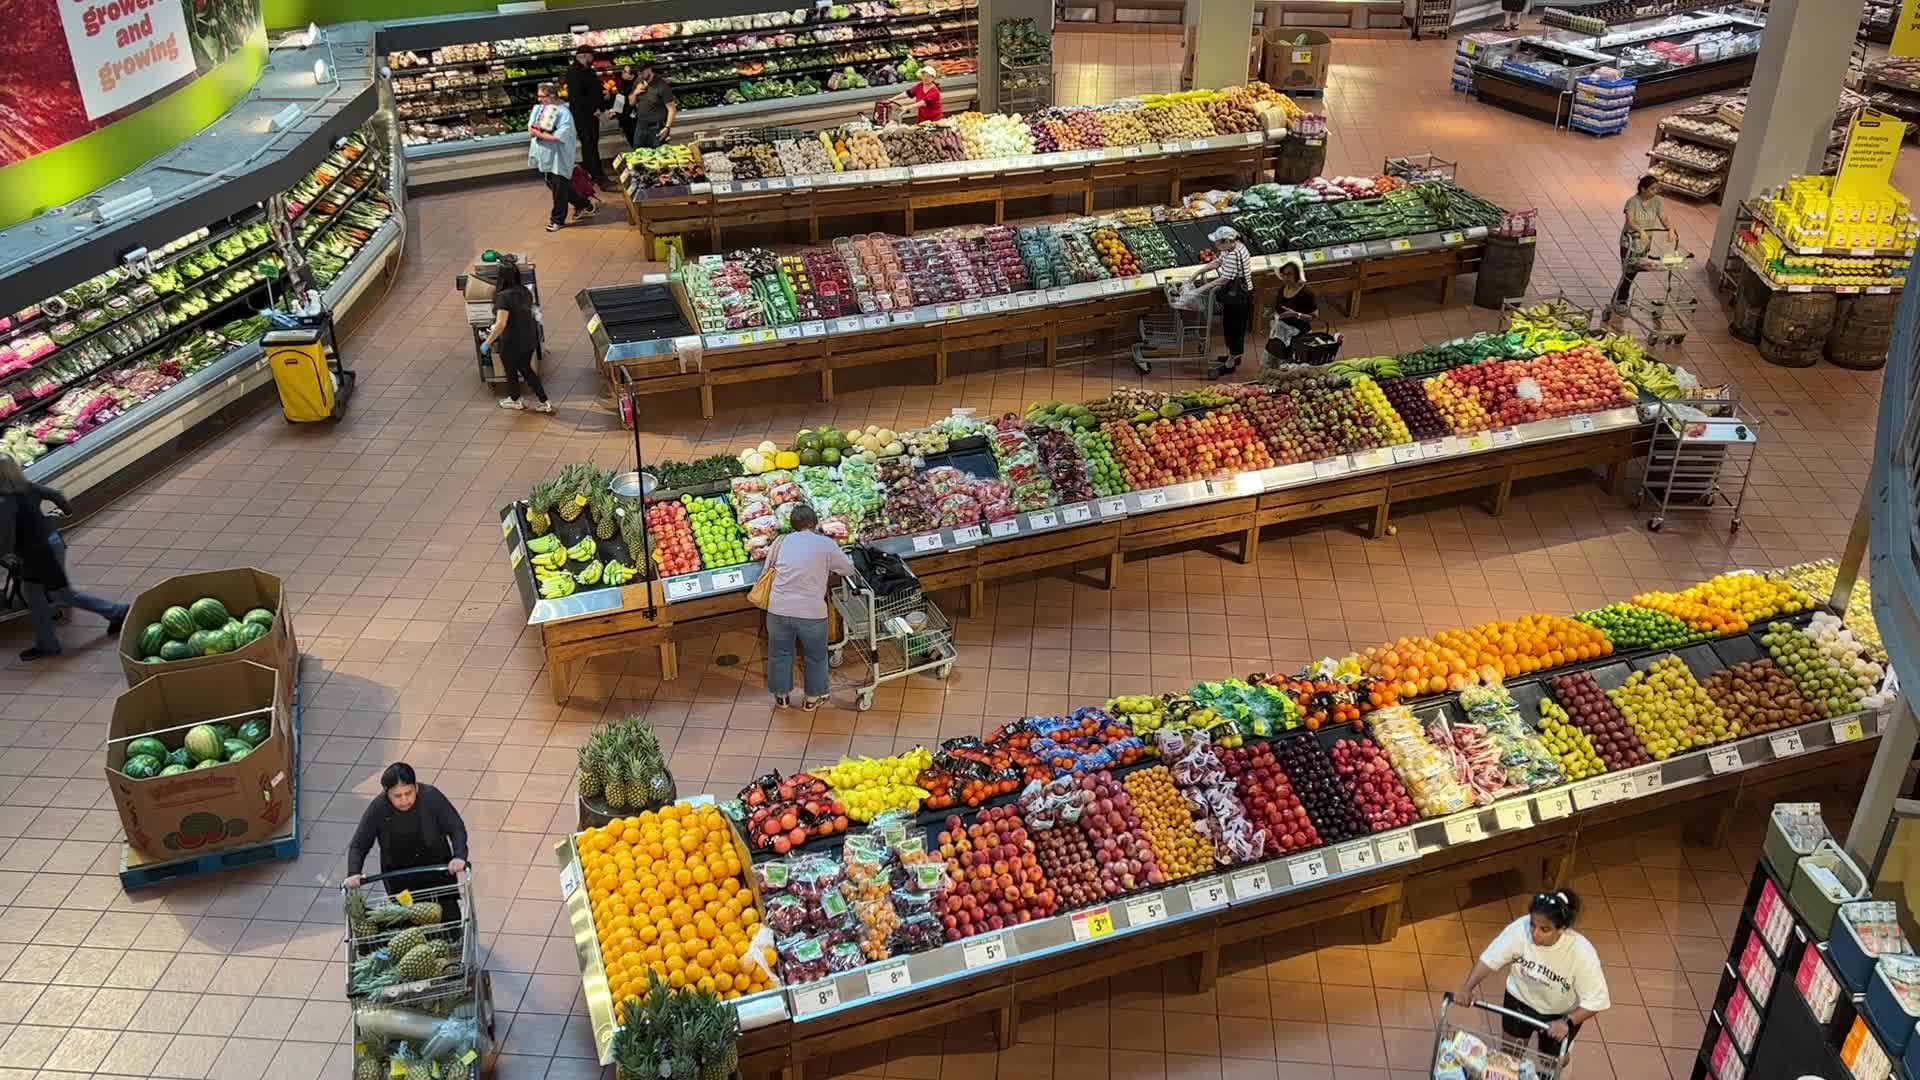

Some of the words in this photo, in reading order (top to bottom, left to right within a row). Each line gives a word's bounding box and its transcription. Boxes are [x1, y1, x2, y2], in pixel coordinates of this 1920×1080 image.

[82, 0, 165, 37] growe
[116, 13, 153, 48] and
[98, 32, 179, 92] growing
